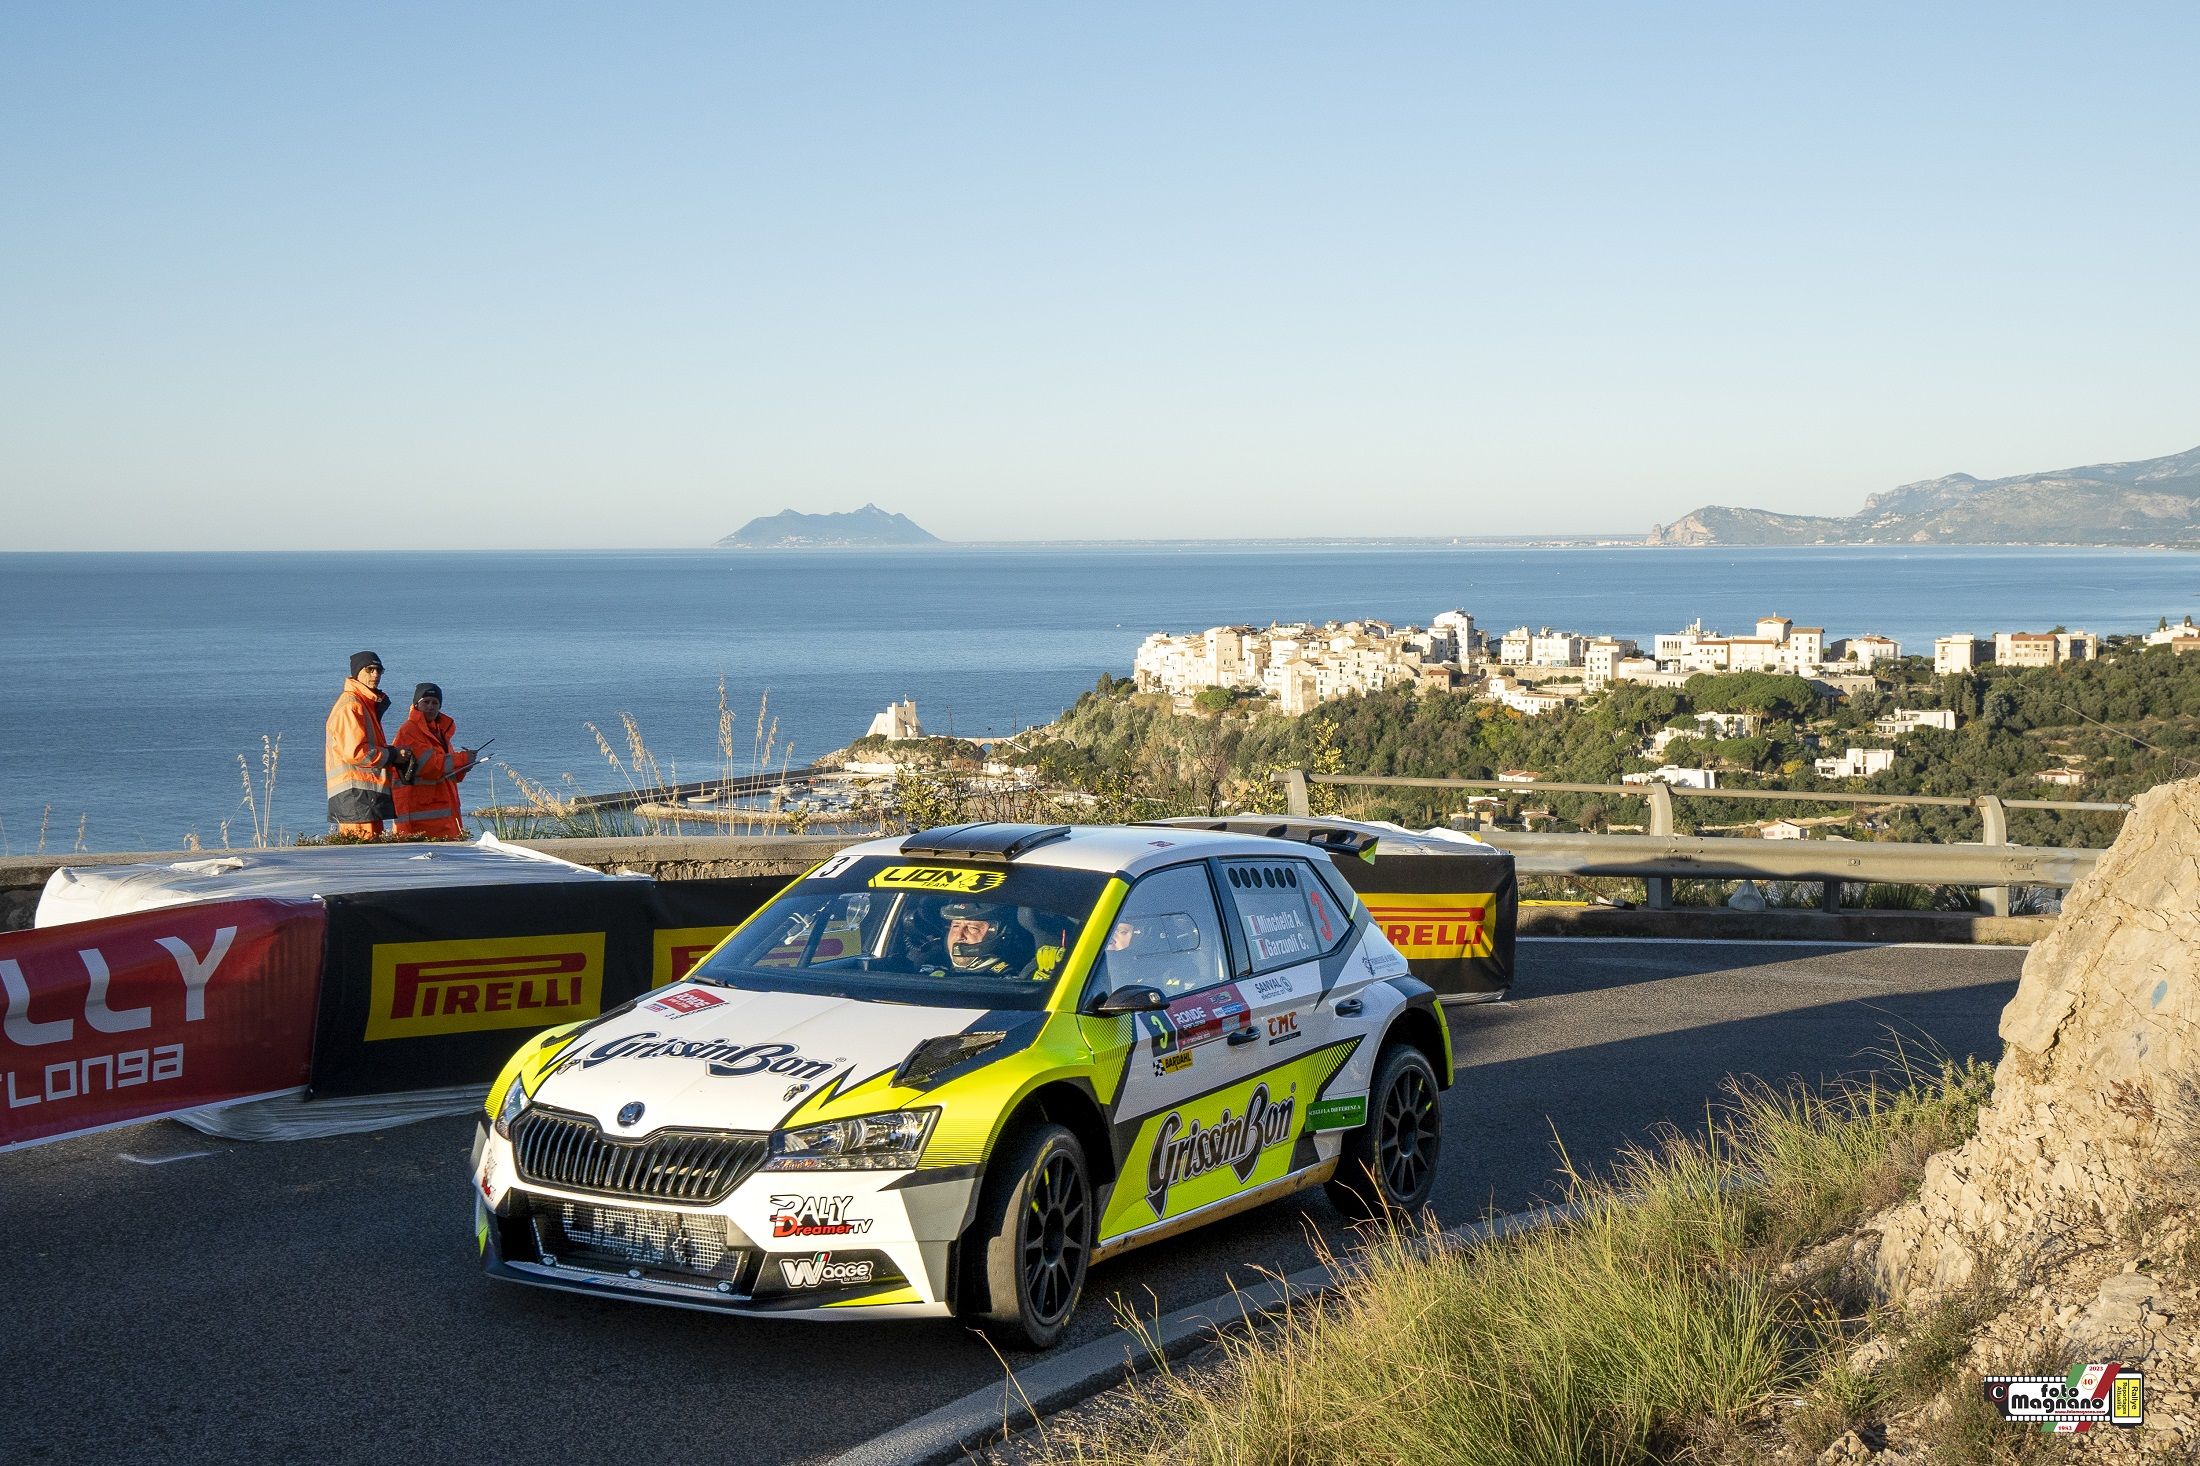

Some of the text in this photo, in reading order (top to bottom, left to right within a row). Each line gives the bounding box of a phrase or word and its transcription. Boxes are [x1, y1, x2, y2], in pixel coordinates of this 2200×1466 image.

[819, 857, 850, 877] 3
[884, 869, 962, 883] LION
[1311, 891, 1333, 942] 3
[1367, 907, 1485, 945] RELLI
[390, 952, 587, 1019] PIRELLI
[1255, 978, 1282, 993] SANVAL
[1151, 1015, 1169, 1049] 3
[1173, 1006, 1207, 1025] RONDE
[770, 1194, 854, 1227] RALLY
